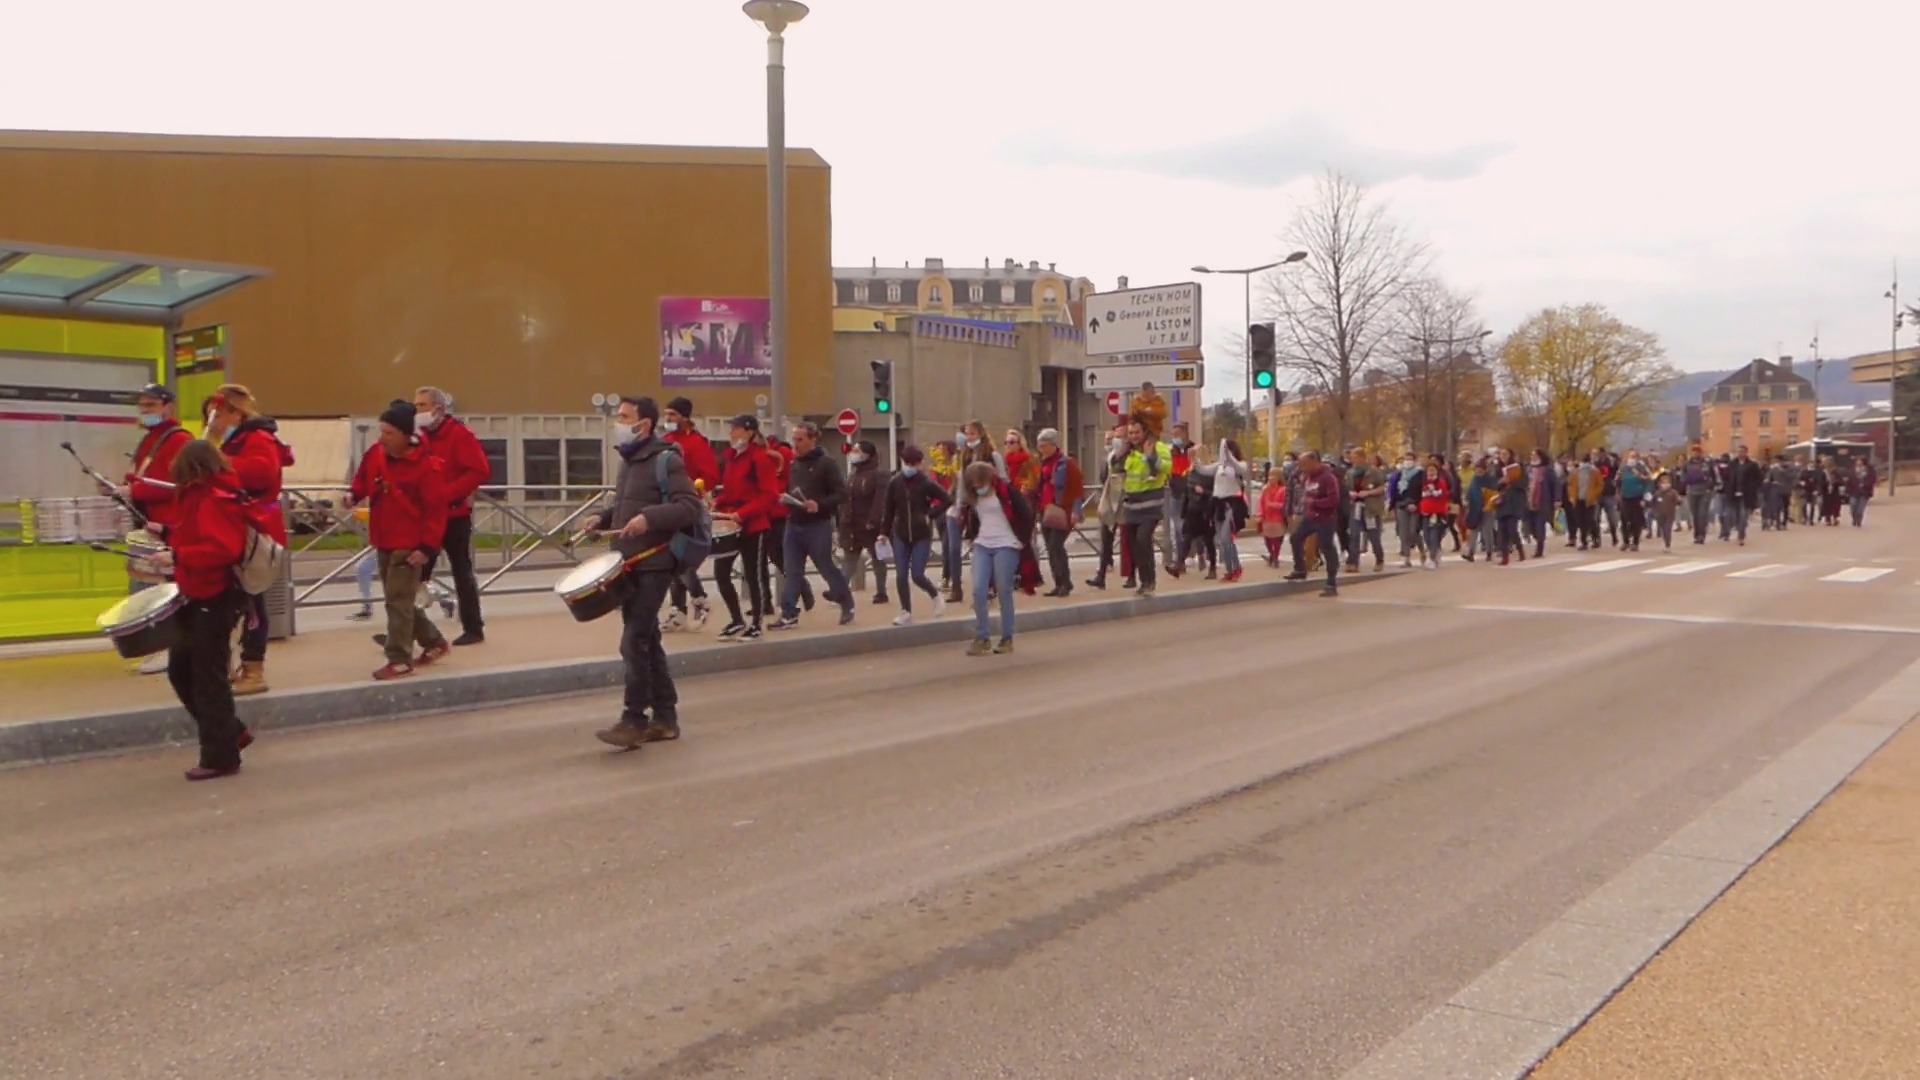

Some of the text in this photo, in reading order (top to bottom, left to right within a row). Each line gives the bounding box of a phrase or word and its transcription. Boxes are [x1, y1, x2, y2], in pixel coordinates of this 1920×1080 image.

[1119, 308, 1154, 321] General
[1156, 304, 1192, 317] Electric
[1146, 317, 1192, 331] ALSTOM
[663, 367, 711, 376] Institution
